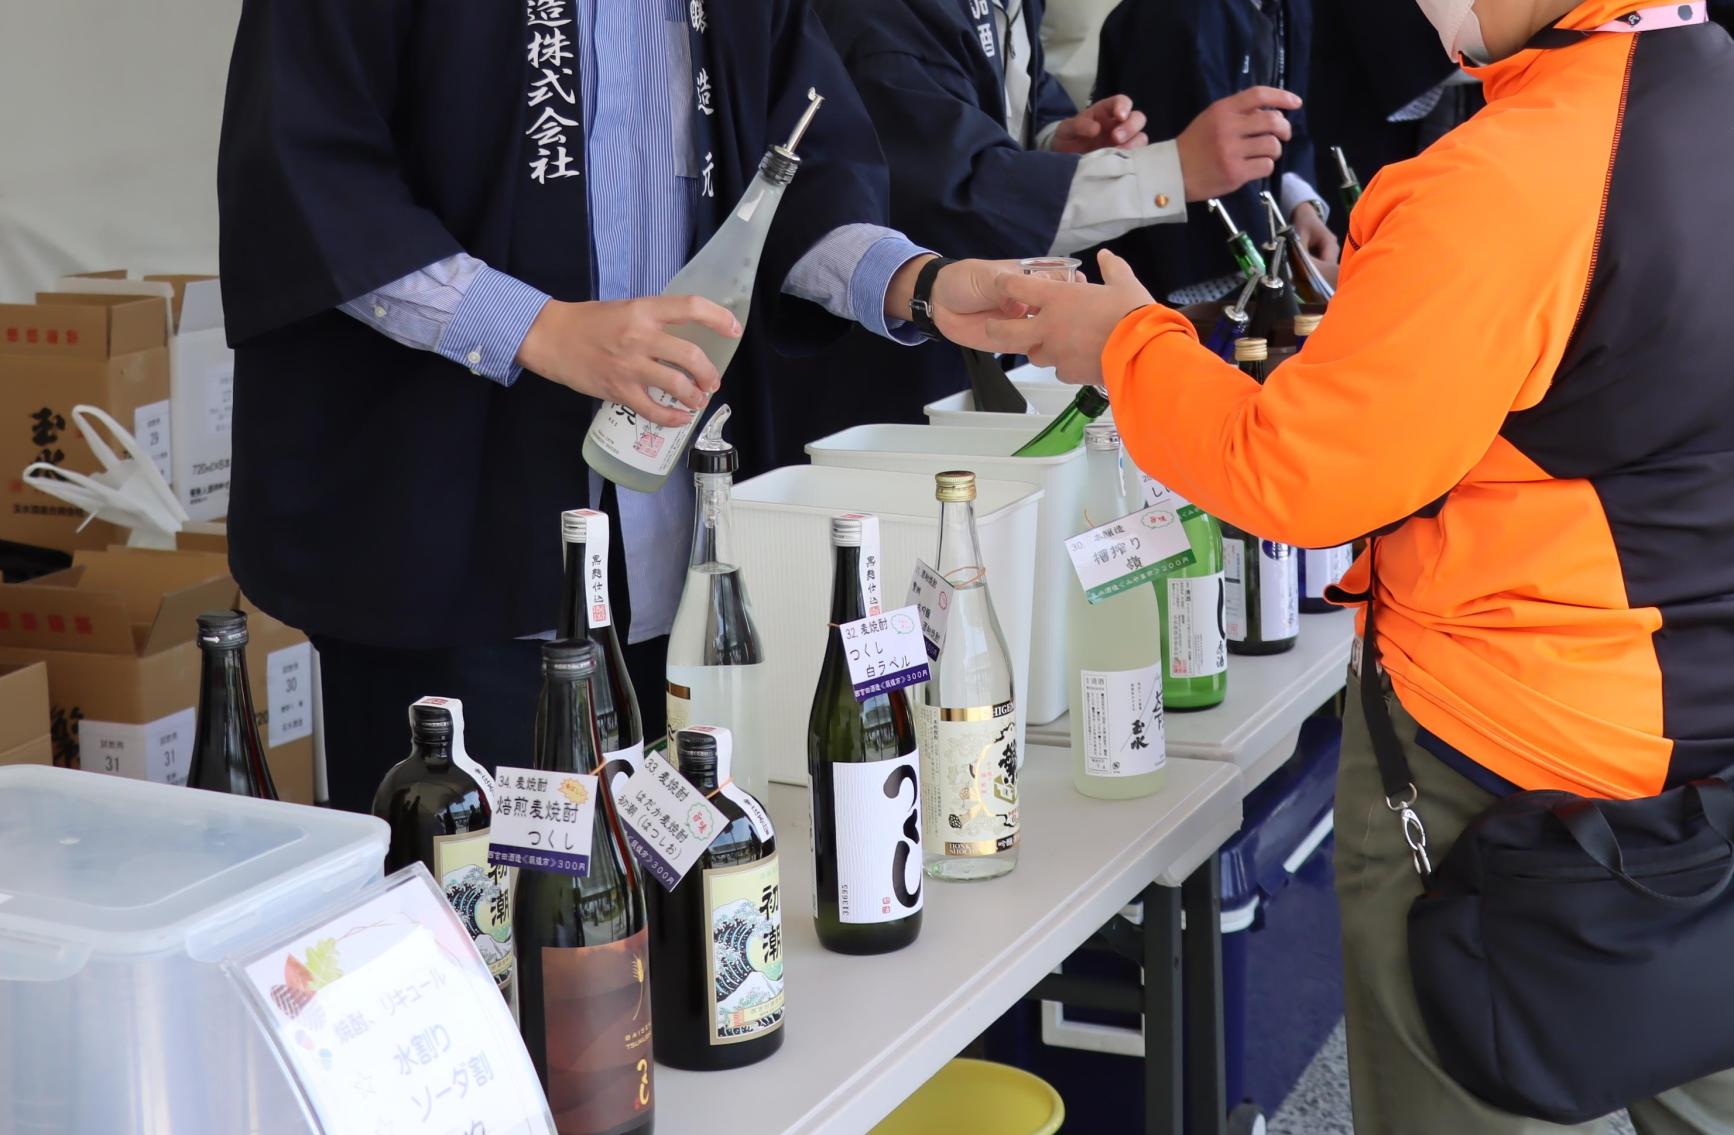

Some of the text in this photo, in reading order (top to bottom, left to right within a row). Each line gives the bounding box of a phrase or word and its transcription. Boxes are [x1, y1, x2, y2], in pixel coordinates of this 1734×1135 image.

[861, 617, 888, 635] 麦焼酎
[849, 641, 883, 661] つくし
[866, 655, 911, 678] 白ラベル
[286, 677, 298, 693] 30
[105, 756, 120, 772] 31
[164, 749, 176, 766] 31
[515, 776, 548, 793] 麦焼酎
[658, 771, 689, 802] 麦焼酎
[495, 796, 579, 824] 焙煎麦焼酎
[635, 790, 688, 844] はだか麦焼酎
[527, 829, 574, 851] つくし
[758, 884, 782, 964] 初潮
[378, 967, 447, 1017] リキュール
[392, 1023, 452, 1076] 水割り
[411, 1049, 495, 1124] ソーダ割
